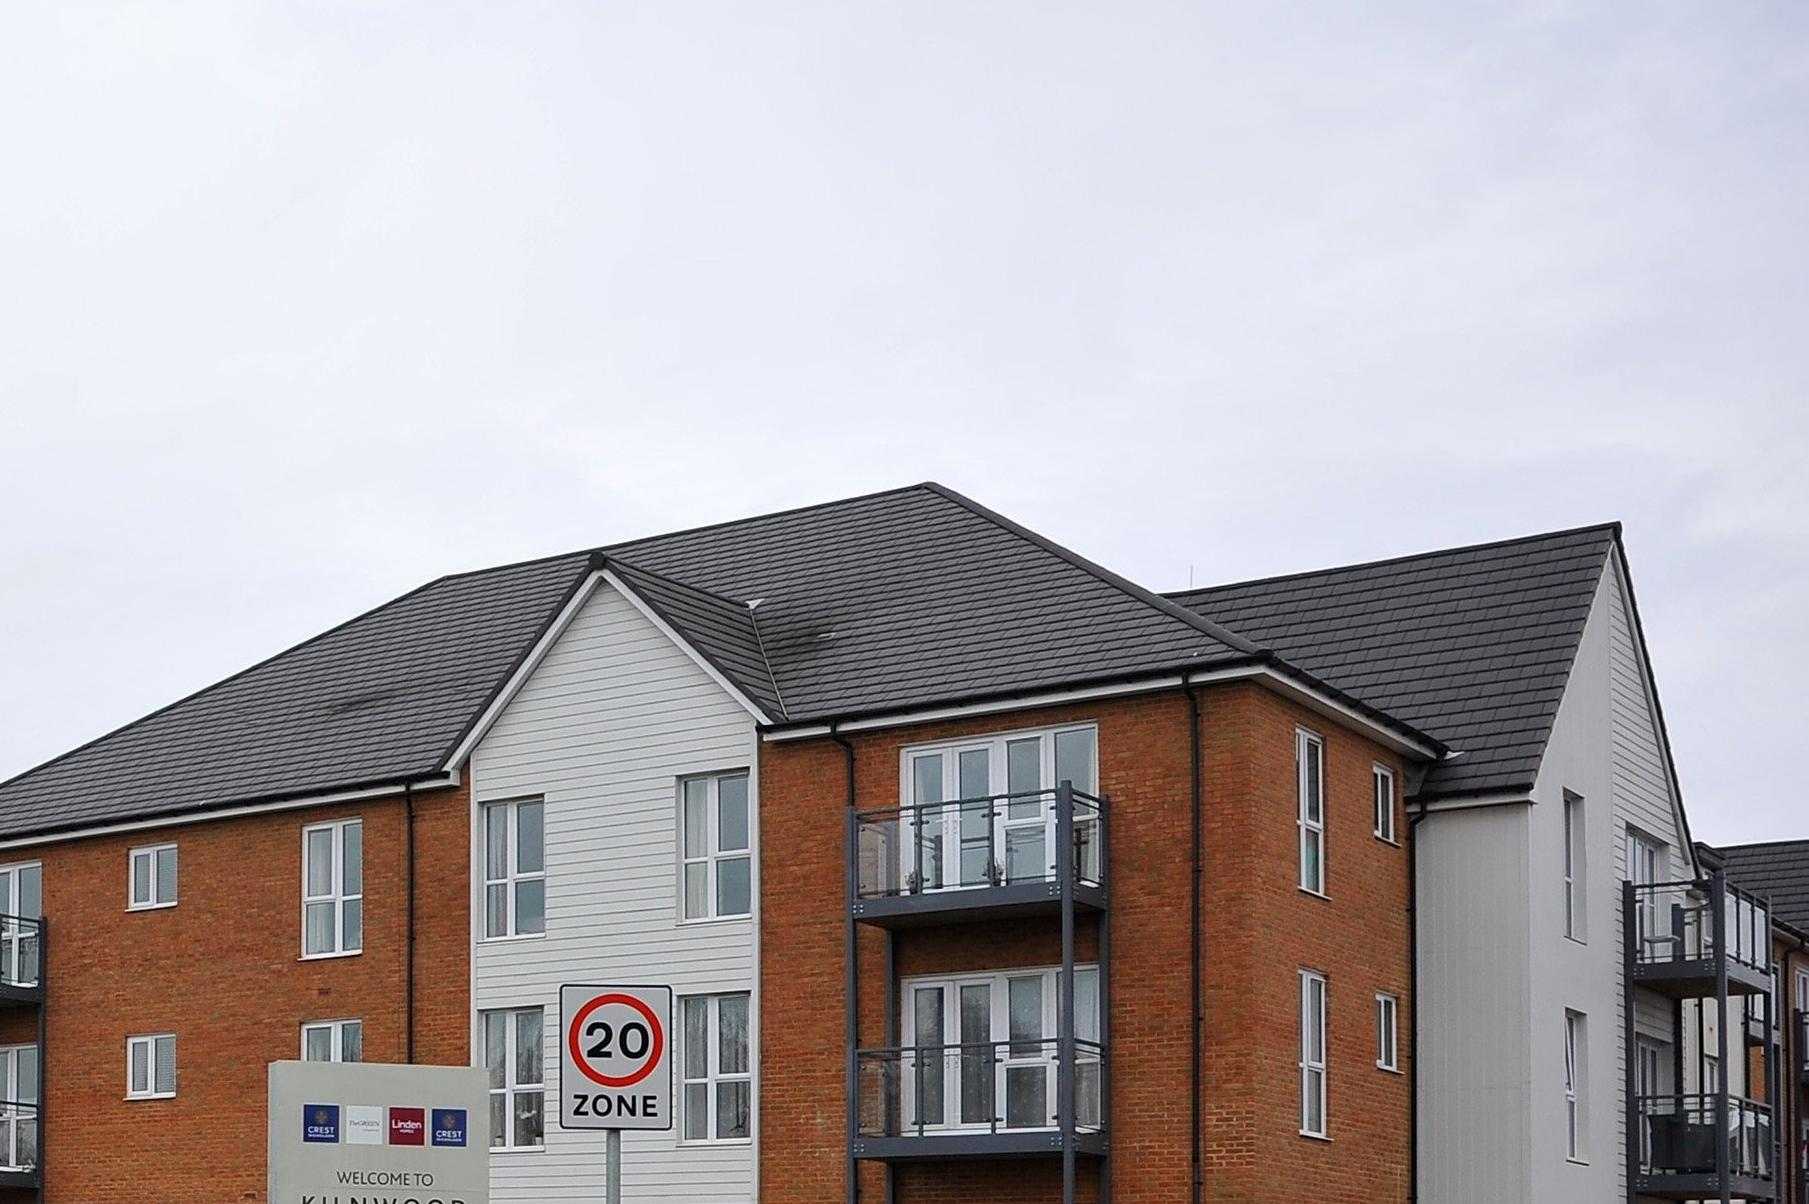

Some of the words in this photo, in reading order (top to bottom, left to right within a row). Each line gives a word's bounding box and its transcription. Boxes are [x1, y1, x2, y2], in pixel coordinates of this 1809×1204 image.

[585, 1021, 650, 1060] 20
[572, 1093, 658, 1118] ZONE
[307, 1125, 336, 1134] CREST
[391, 1118, 423, 1130] Linden
[435, 1129, 463, 1138] CREST
[336, 1171, 411, 1186] WELCOME
[413, 1173, 434, 1187] TO
